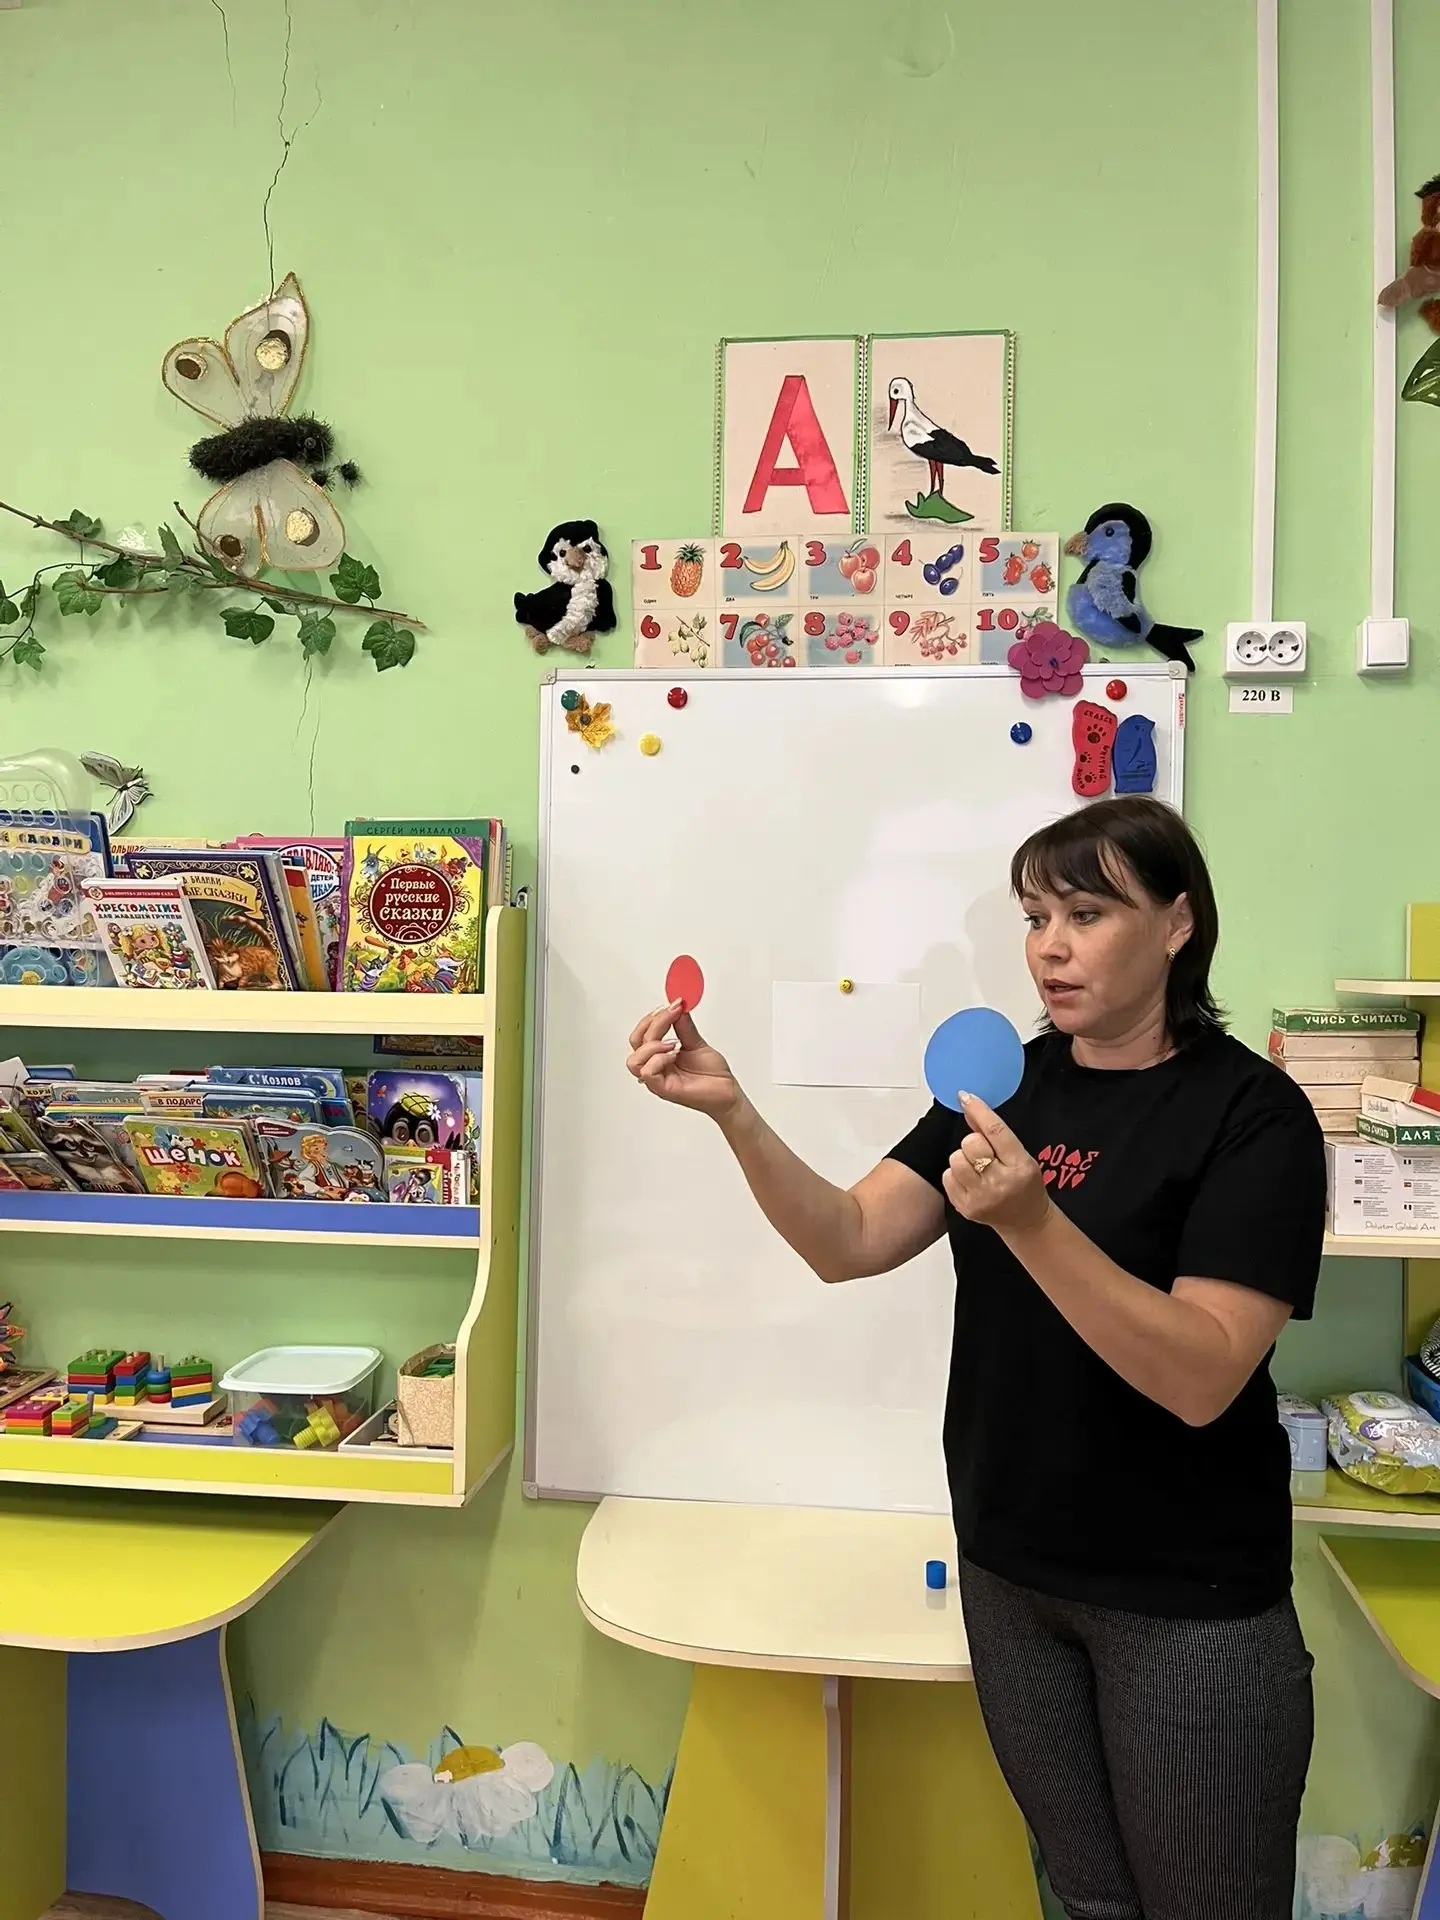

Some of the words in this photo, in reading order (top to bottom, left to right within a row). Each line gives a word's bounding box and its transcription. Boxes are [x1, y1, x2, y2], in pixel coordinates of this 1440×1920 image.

[640, 545, 662, 570] 1
[720, 543, 743, 569] 2
[805, 541, 826, 566] 3
[892, 539, 912, 566] 4
[979, 538, 1000, 563] 5
[640, 615, 661, 639] 6
[720, 614, 739, 640] 7
[804, 612, 825, 636] 8
[889, 611, 910, 636] 9
[976, 609, 1019, 631] 10
[1242, 690, 1266, 701] 220
[1271, 690, 1281, 701] В
[367, 827, 404, 835] СЕРГЕЙ
[411, 826, 467, 835] МИХАЛКОВ
[204, 887, 248, 904] СКАЗКИ
[390, 878, 436, 892] Первые
[385, 892, 440, 906] русские
[379, 907, 443, 921] Сказки
[1304, 1015, 1346, 1024] УЧИСЬ
[1351, 1014, 1407, 1024] СЧИТАТЬ
[1401, 1130, 1431, 1141] ДЛЯ
